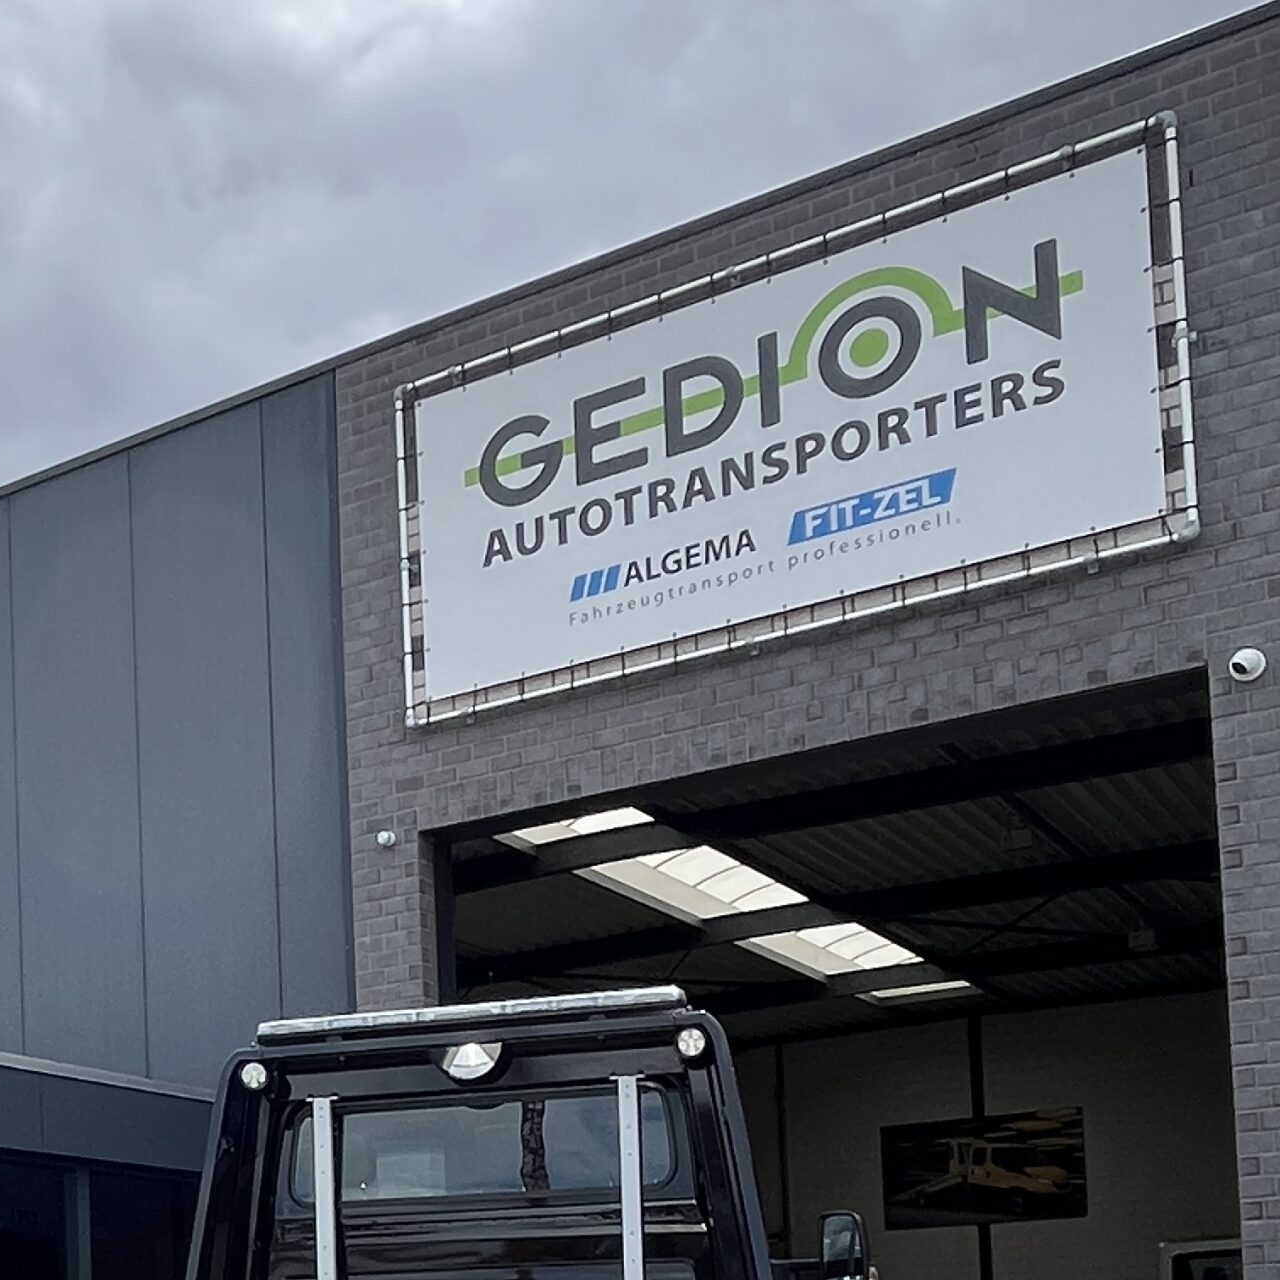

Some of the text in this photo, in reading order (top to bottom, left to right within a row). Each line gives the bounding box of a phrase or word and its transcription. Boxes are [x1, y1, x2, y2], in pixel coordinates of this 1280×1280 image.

[478, 238, 1062, 507] GEDION
[482, 358, 1066, 567] AUTOTRANSPORTERS
[623, 478, 942, 587] ALGEMA FIT-ZEL
[569, 560, 775, 626] Fahrzeugtransport
